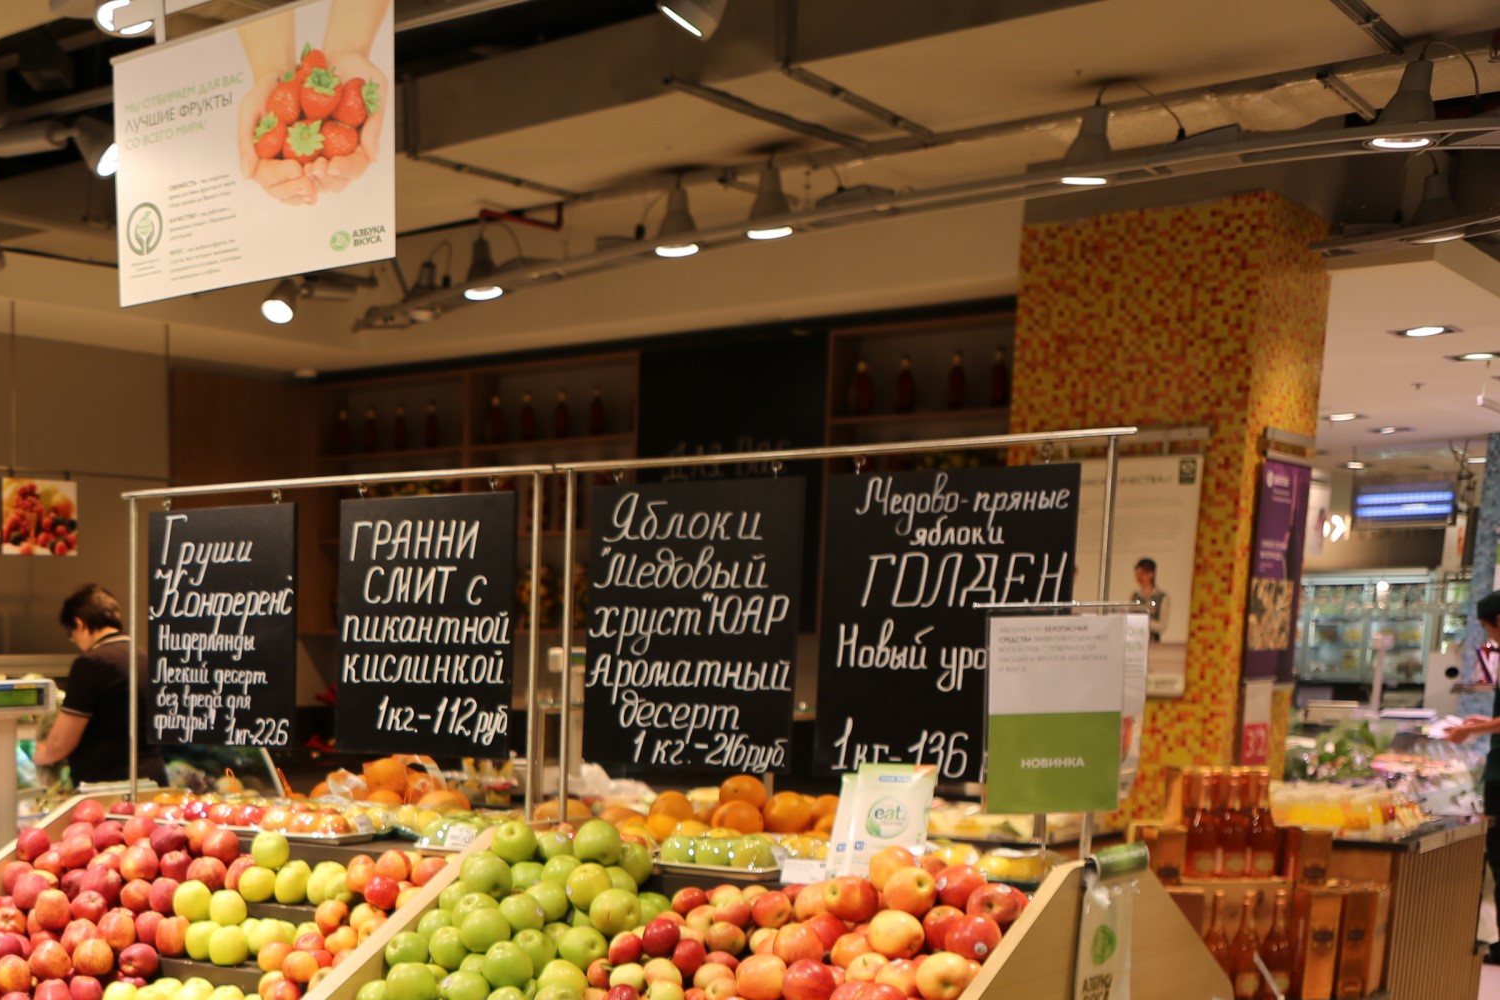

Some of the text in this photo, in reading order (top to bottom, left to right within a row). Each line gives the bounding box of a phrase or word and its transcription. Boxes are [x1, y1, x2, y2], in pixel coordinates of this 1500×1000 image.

[222, 72, 244, 87] ВАС
[126, 92, 233, 133] ЛУЧШИЕ ФРУКТЫ
[125, 137, 140, 150] СО
[142, 128, 174, 146] ВСЕГО
[353, 225, 386, 238] АЗБУКА
[354, 235, 382, 247] ВКУСА
[603, 492, 764, 543] Яблоки
[855, 471, 1071, 537] Медово-пряные
[348, 518, 480, 562] ГРАННИ
[909, 514, 1006, 547] яблоки
[161, 514, 253, 588] Груши
[363, 565, 458, 605] СМИТ
[860, 551, 1069, 608] ГОЛДЕН
[157, 623, 256, 663] Нидерланды
[340, 611, 511, 645] пикантной
[340, 650, 504, 684] кислинкой
[836, 618, 988, 693] Новый уро
[152, 657, 269, 695] Легкий десерт
[585, 653, 792, 706] Ароматный
[156, 685, 252, 721] без вреда для
[618, 689, 740, 745] десерт
[1020, 756, 1085, 769] НОВИНКА
[874, 805, 902, 820] eat
